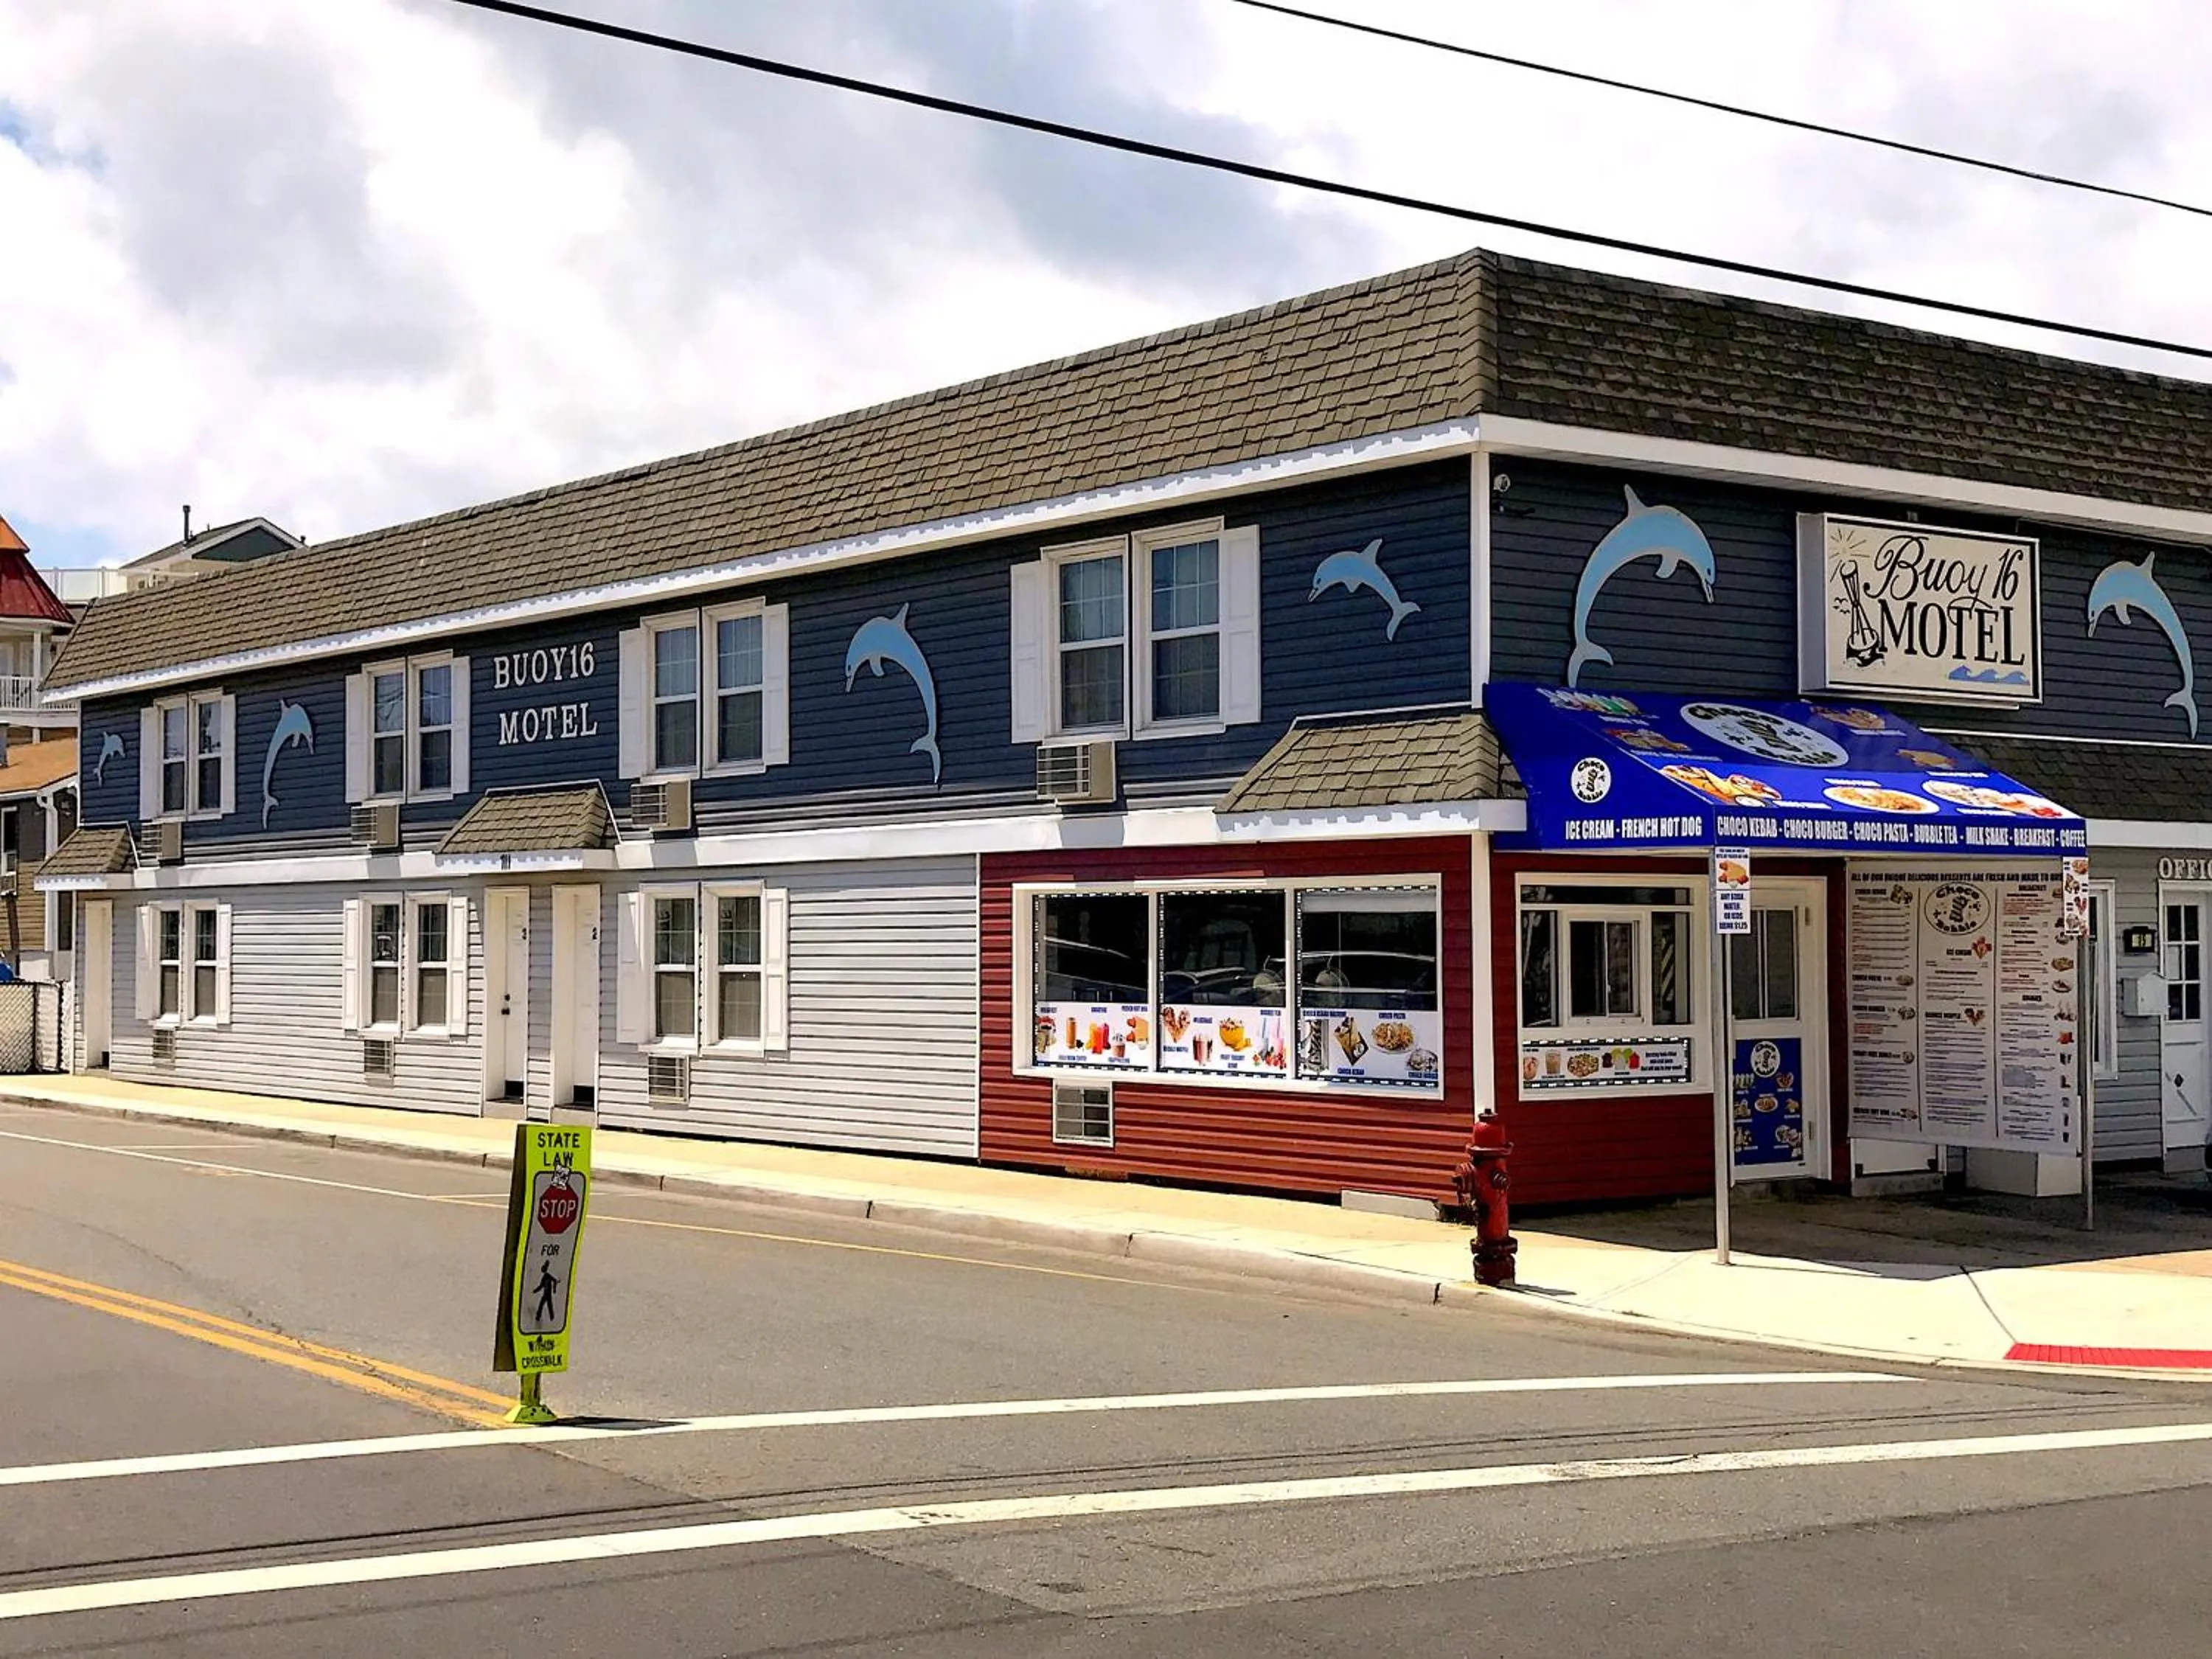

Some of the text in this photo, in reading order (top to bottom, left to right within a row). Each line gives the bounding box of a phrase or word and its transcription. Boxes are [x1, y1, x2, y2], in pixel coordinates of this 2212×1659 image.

[1863, 535, 2024, 621] Buoy 16
[1877, 598, 2025, 666] MOTEL
[493, 641, 595, 689] BUOY16
[498, 702, 598, 745] MOTEL
[1578, 760, 1605, 772] Choco
[1565, 816, 1703, 840] ICE CREAM FRENCH HOT DOG
[1717, 815, 2086, 848] CHOCO KEBAB CHOCO BURGER CHOCO PASTA BUBBLE TEA MILK SHAKE BREAKFAST COFFEE
[1935, 886, 1980, 900] Choco
[538, 1132, 580, 1148] STATE
[543, 1151, 574, 1167] LAW
[540, 1200, 577, 1218] STOP
[541, 1244, 560, 1256] FOR
